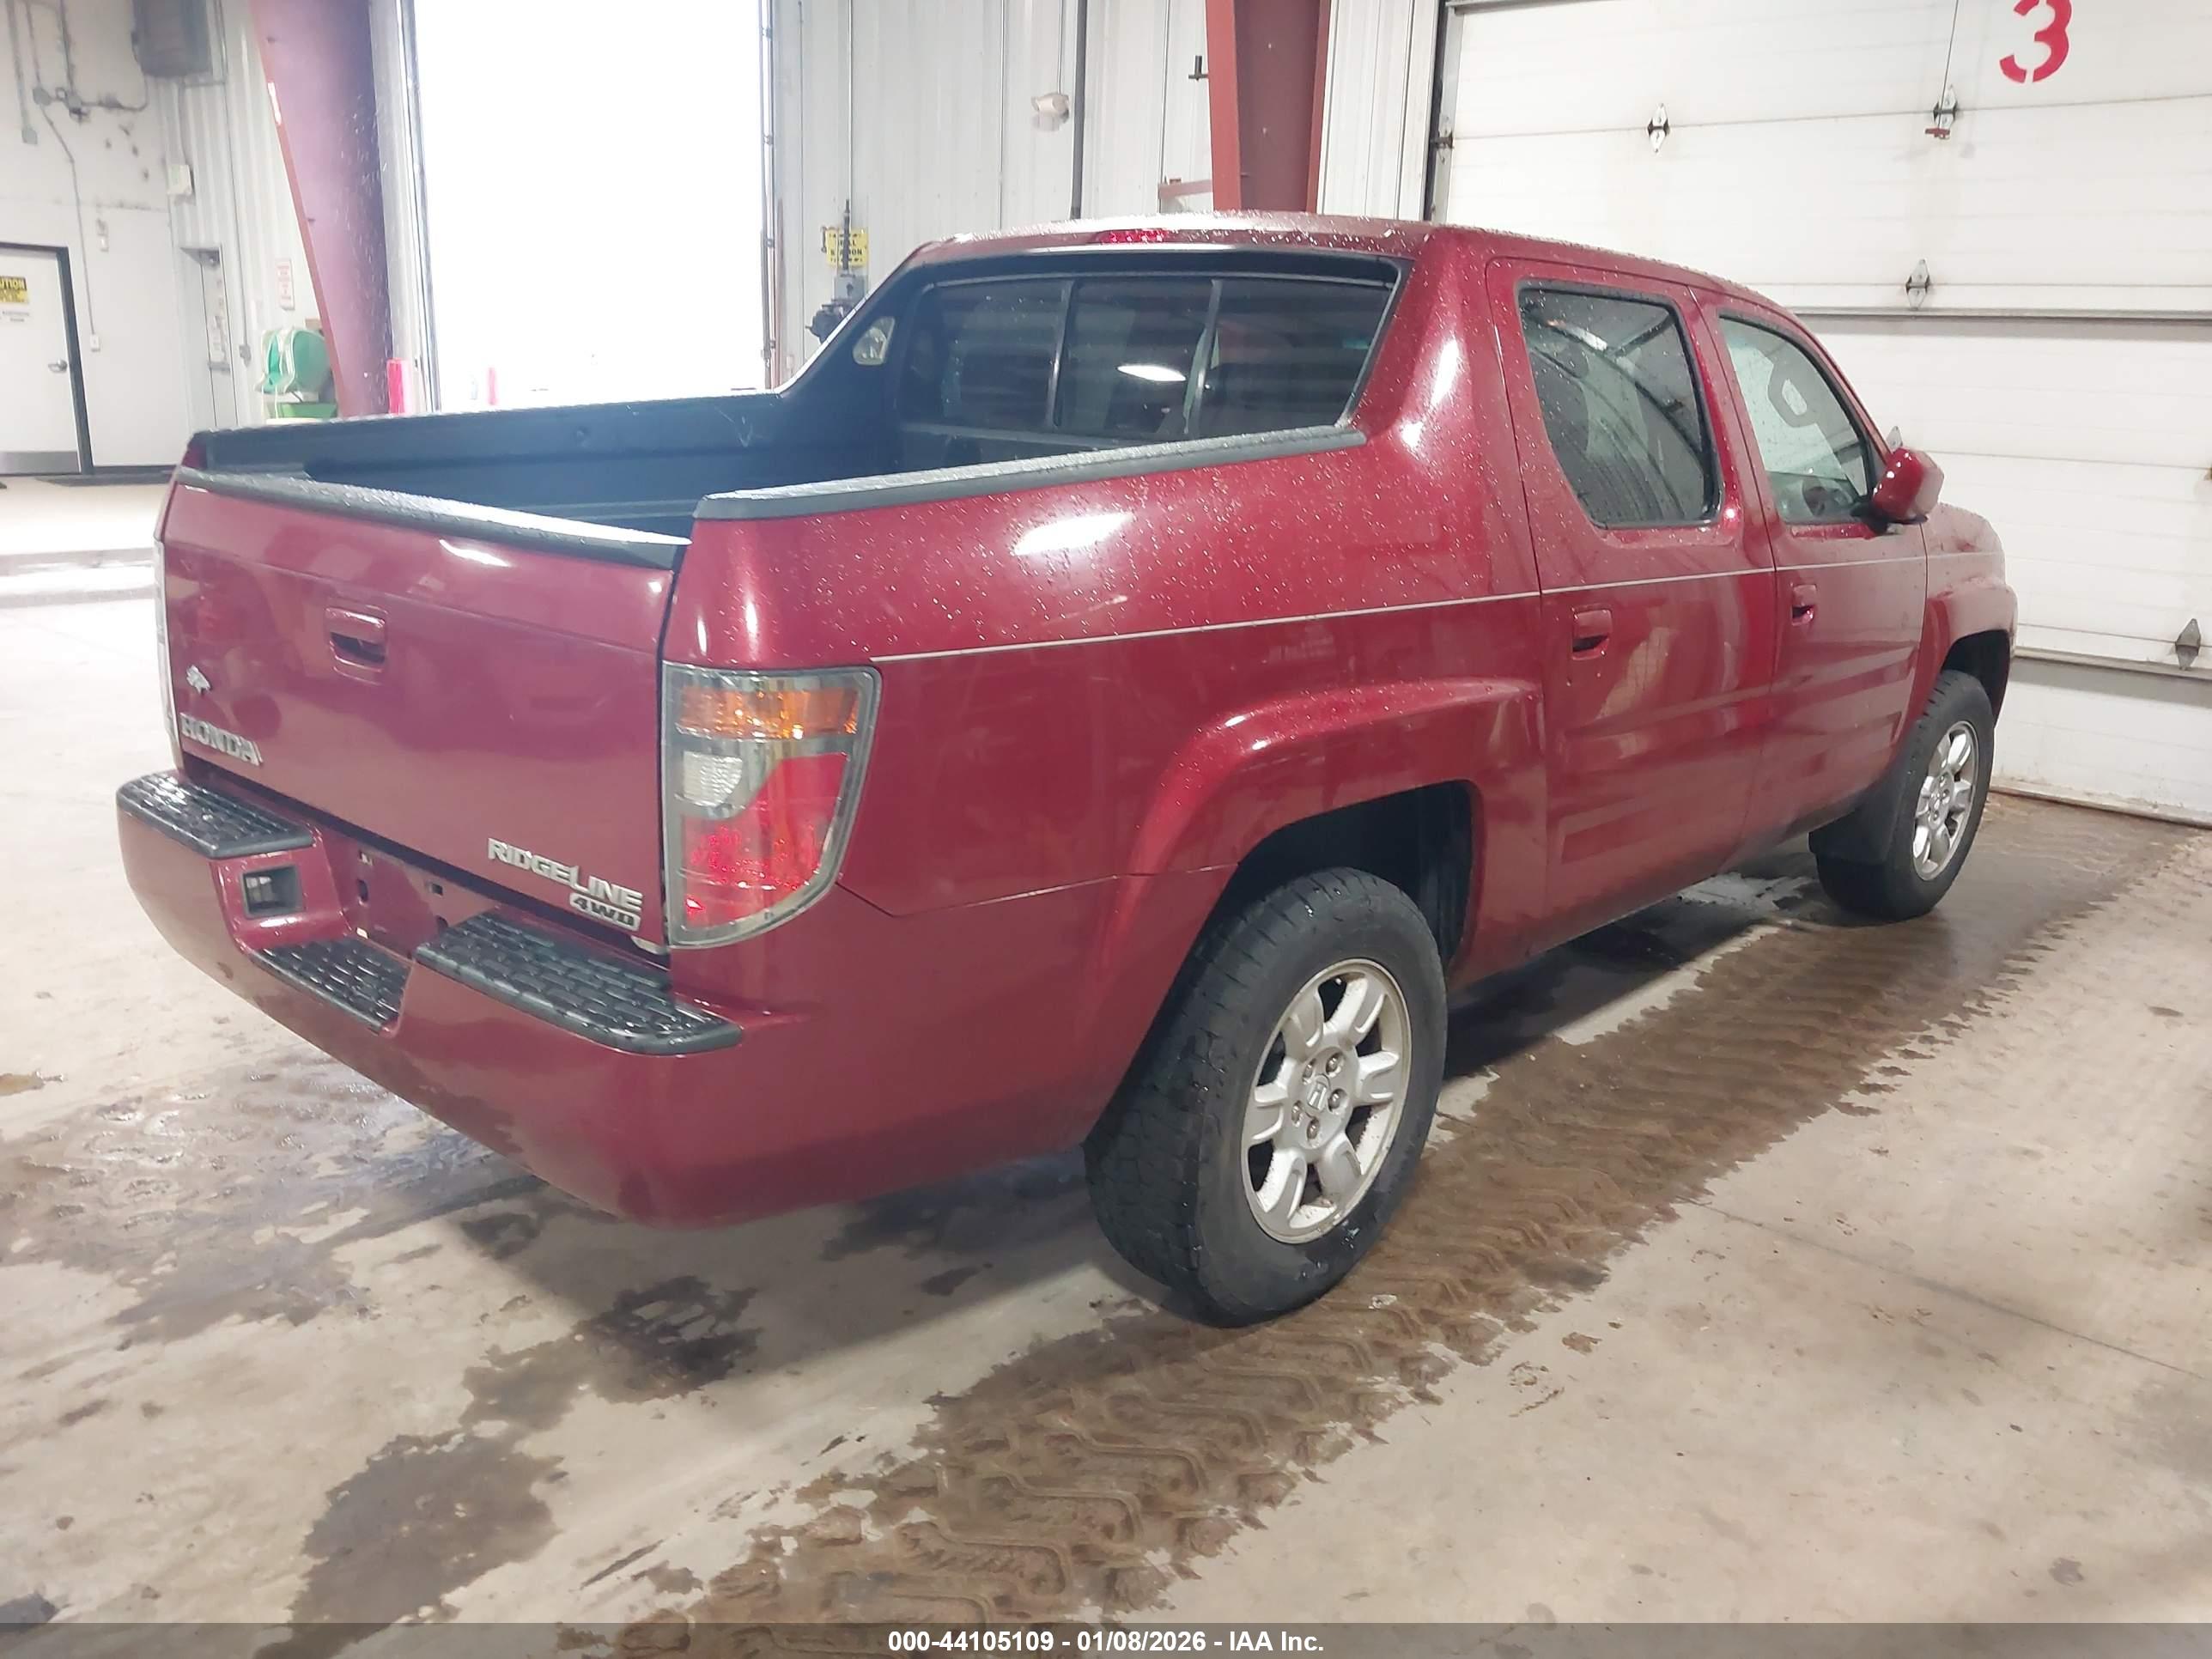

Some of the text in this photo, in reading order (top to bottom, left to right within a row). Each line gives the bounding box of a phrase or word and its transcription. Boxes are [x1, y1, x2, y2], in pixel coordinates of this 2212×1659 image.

[1999, 0, 2071, 83] 3
[179, 712, 263, 766] HONDA
[488, 837, 643, 911] RIDGELINE
[572, 896, 637, 929] 4WD
